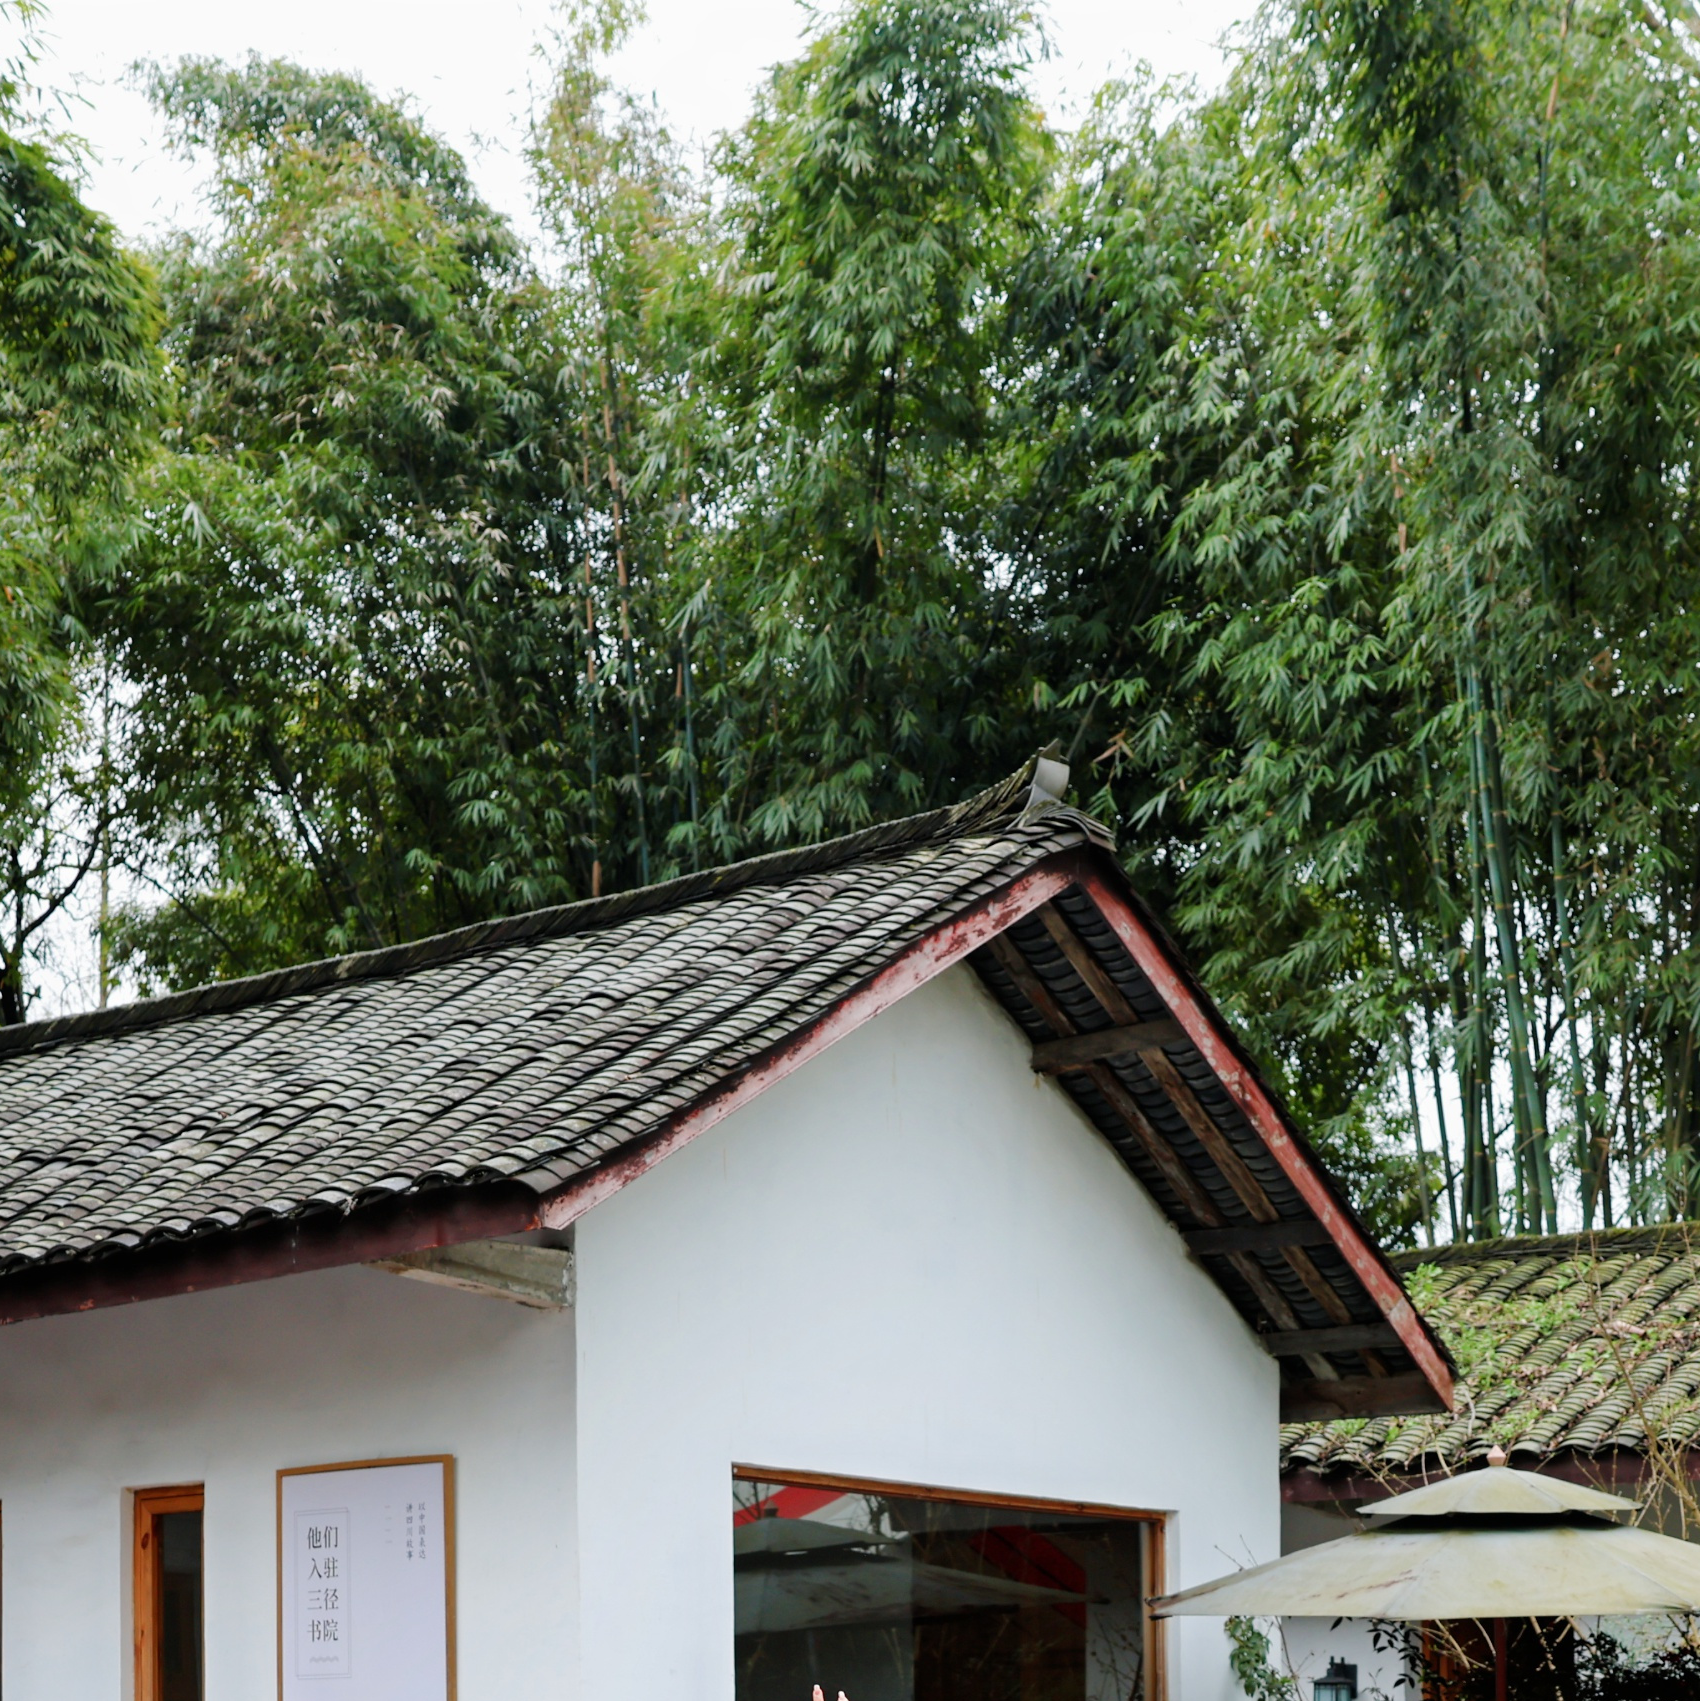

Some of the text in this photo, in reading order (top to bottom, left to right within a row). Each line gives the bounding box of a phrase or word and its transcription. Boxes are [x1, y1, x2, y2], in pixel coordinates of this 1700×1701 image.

[307, 1526, 338, 1549] 他们
[307, 1557, 338, 1580] 入驻
[307, 1588, 338, 1611] 三径
[307, 1619, 338, 1642] 书院
